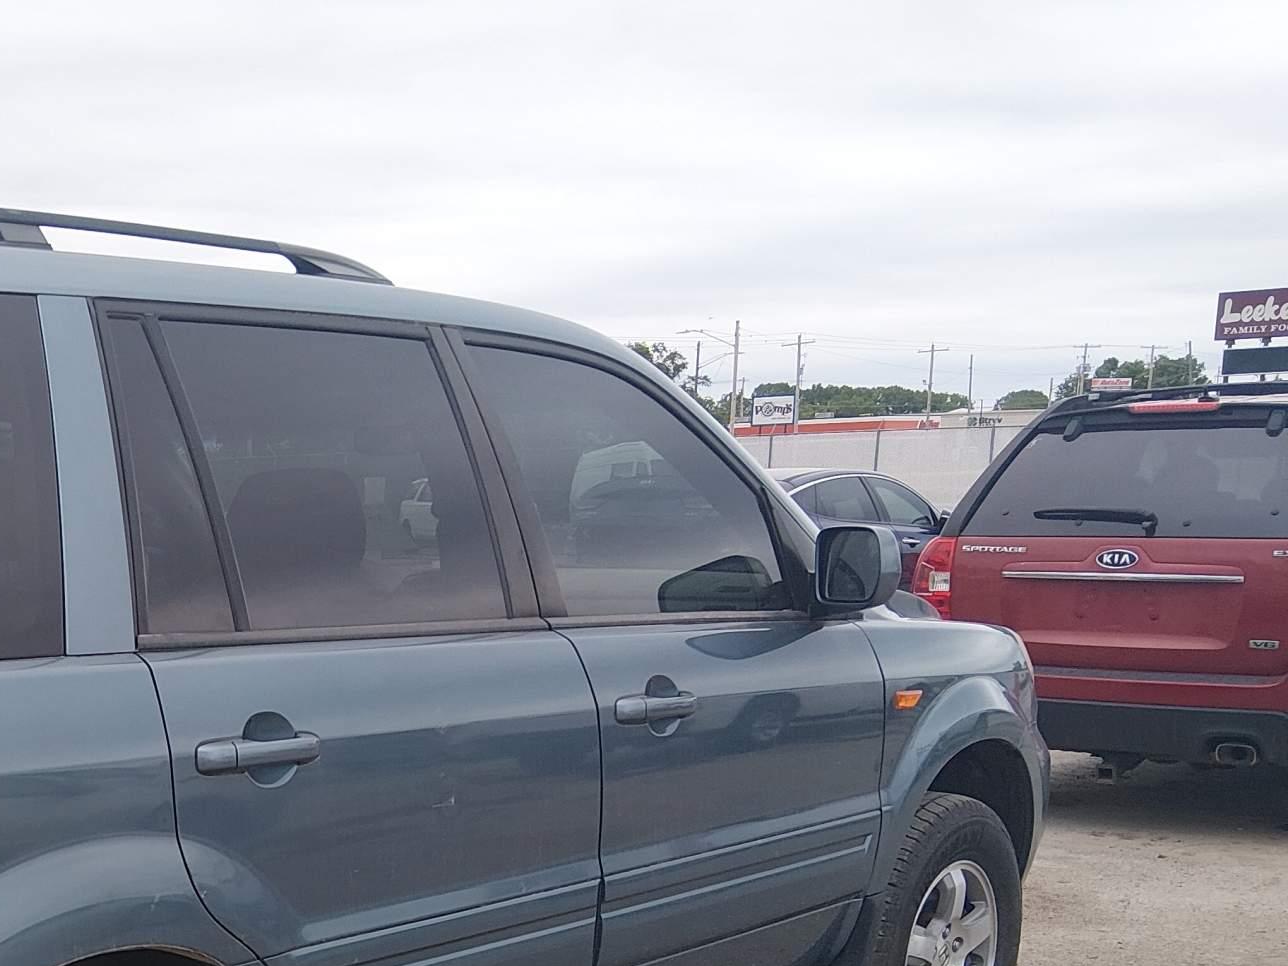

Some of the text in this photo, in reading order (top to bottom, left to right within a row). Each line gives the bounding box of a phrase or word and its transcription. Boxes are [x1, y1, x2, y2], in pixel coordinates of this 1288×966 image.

[1224, 324, 1288, 334] FAMILY FO
[962, 545, 1027, 553] SPORTAGE
[1103, 553, 1130, 565] KIA
